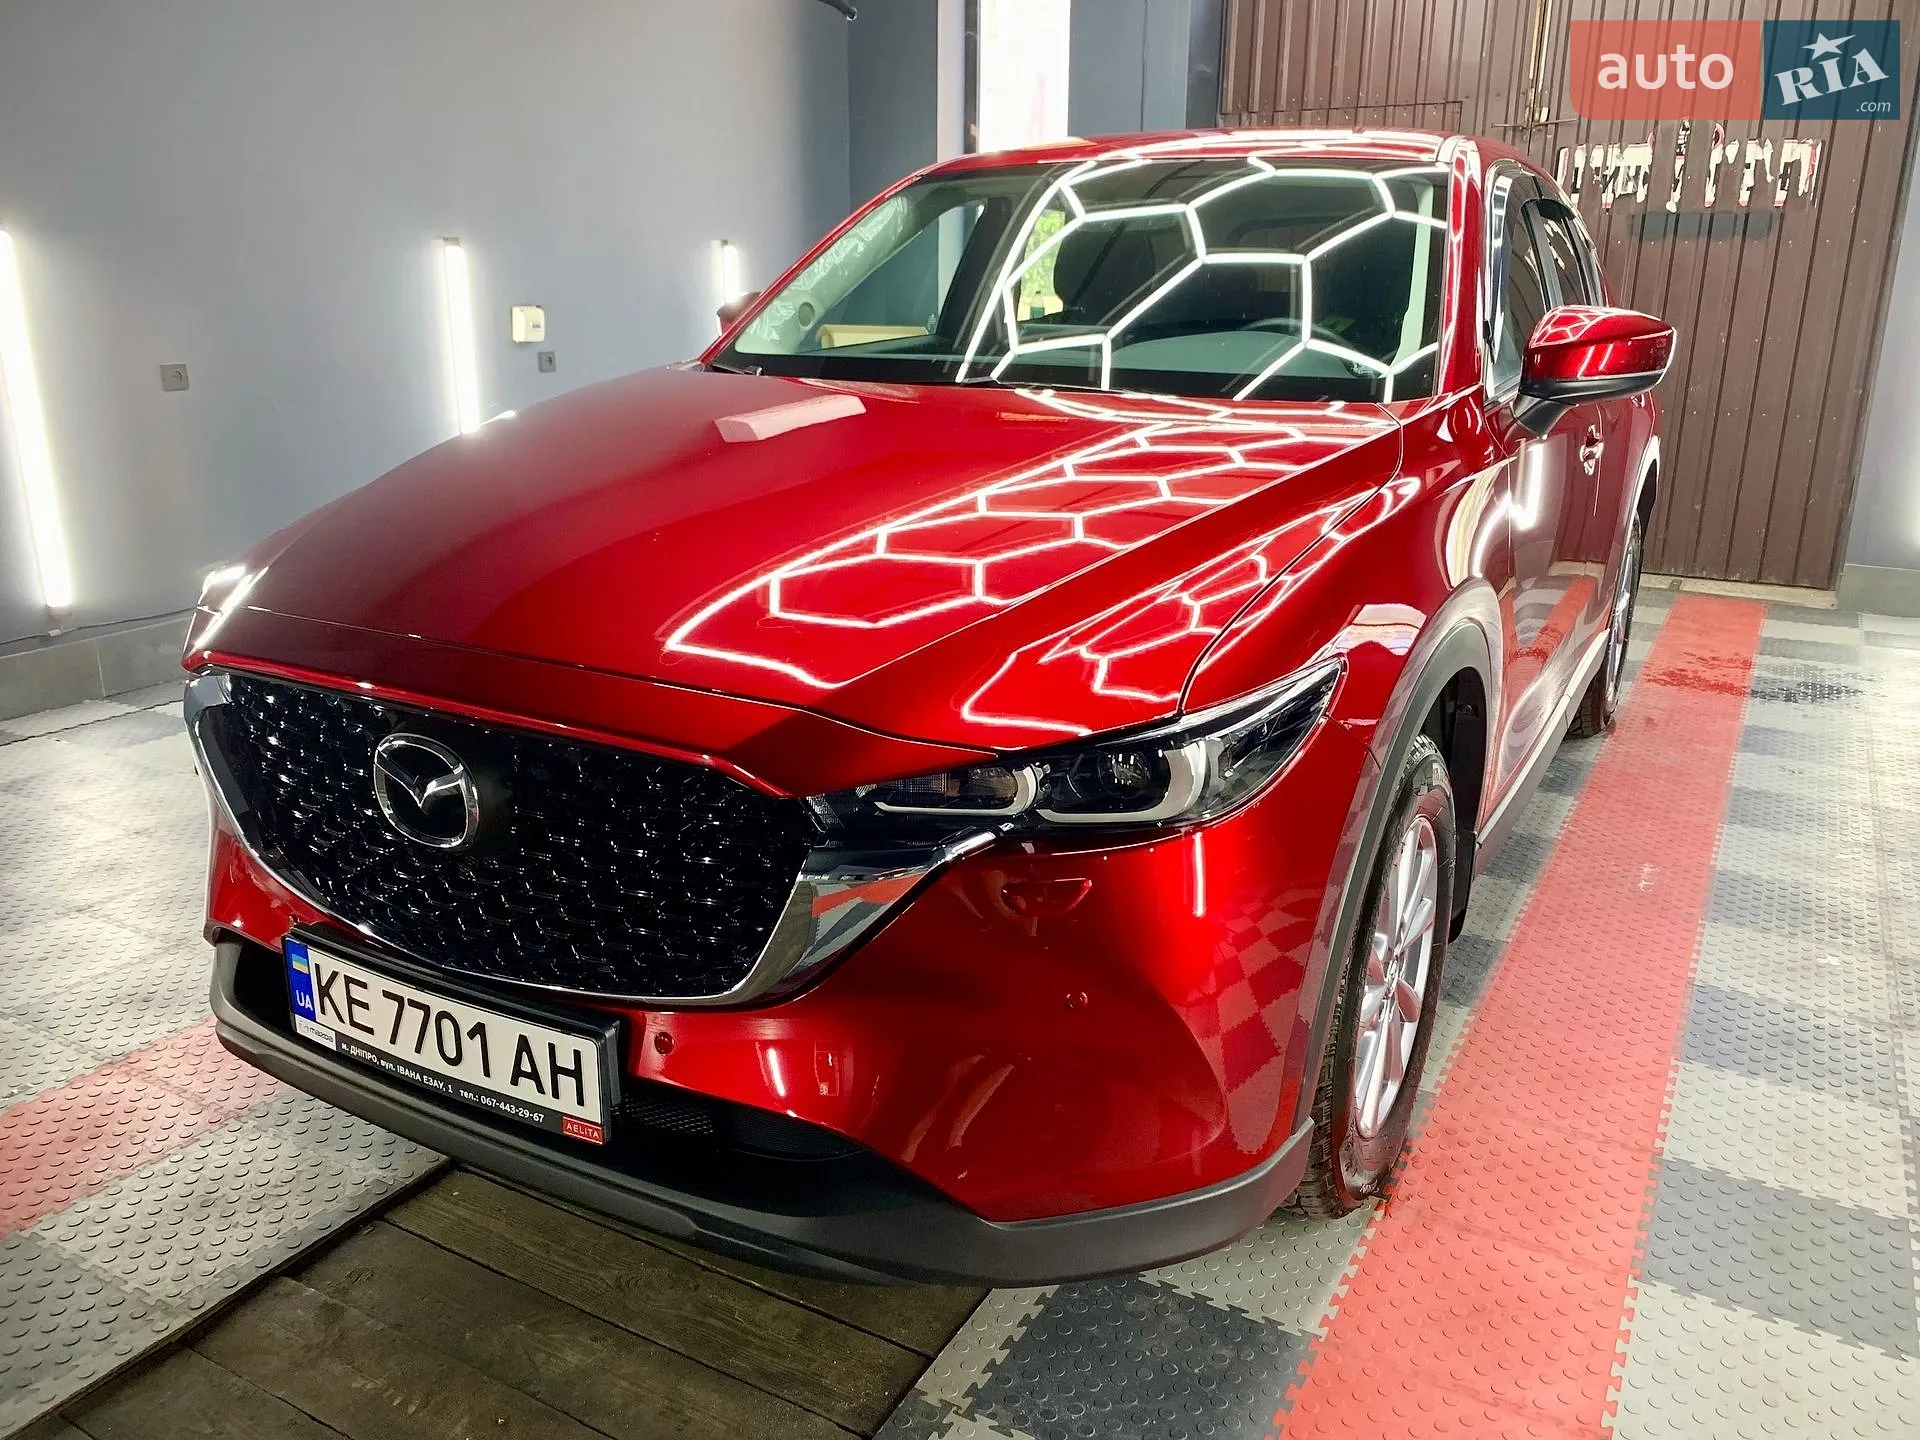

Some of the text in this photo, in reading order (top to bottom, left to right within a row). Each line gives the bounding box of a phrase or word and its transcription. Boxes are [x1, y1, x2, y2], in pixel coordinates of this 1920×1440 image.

[295, 989, 314, 1011] UA
[315, 963, 585, 1107] KE 7701 AH
[397, 1065, 421, 1081] ІВАНА
[447, 1084, 453, 1093] 1
[480, 1095, 545, 1123] 067-443-29-67
[566, 1122, 600, 1139] AELITA
